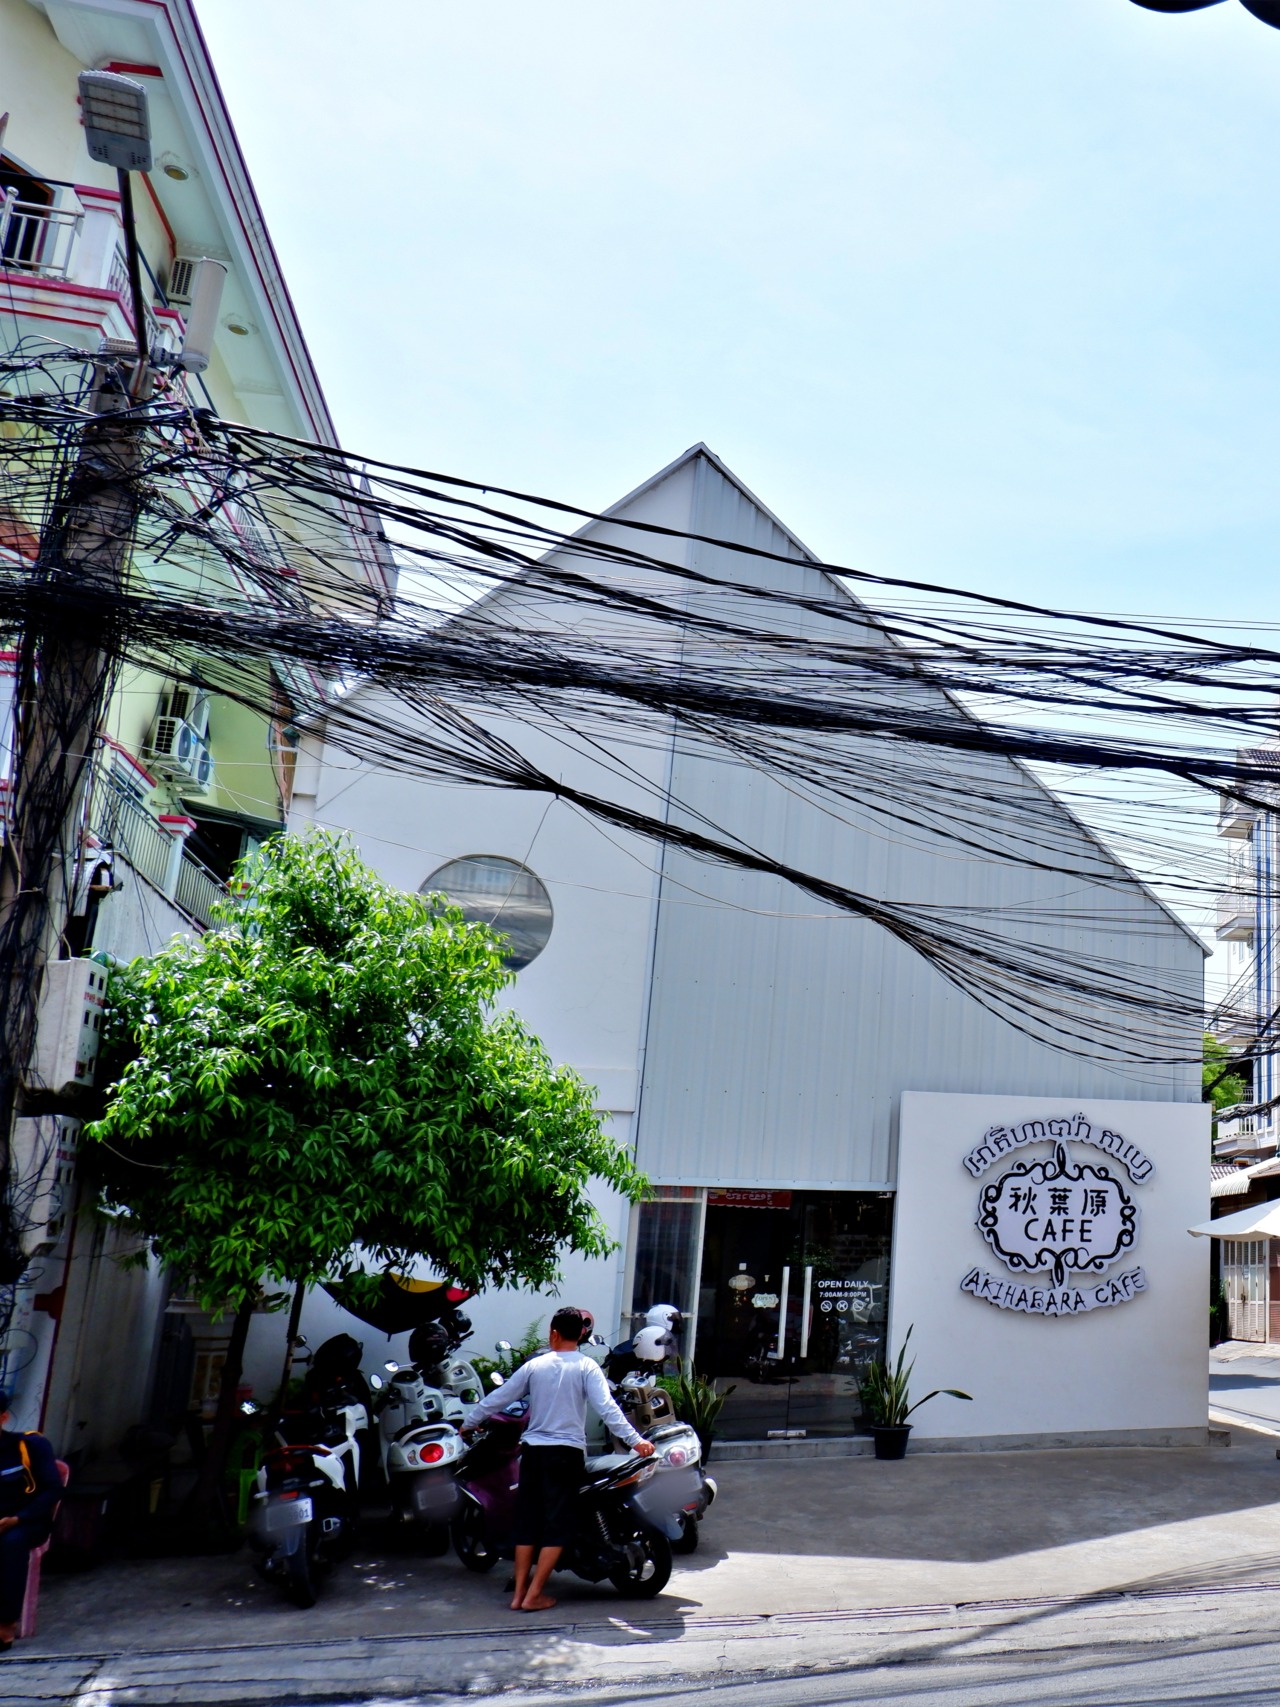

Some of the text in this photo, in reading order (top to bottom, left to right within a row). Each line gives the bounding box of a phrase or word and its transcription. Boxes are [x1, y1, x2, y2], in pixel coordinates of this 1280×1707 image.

[1008, 1186, 1109, 1217] 秋葉原
[1024, 1218, 1093, 1242] CAFE
[965, 1271, 1145, 1311] AKIHABARA CAFE
